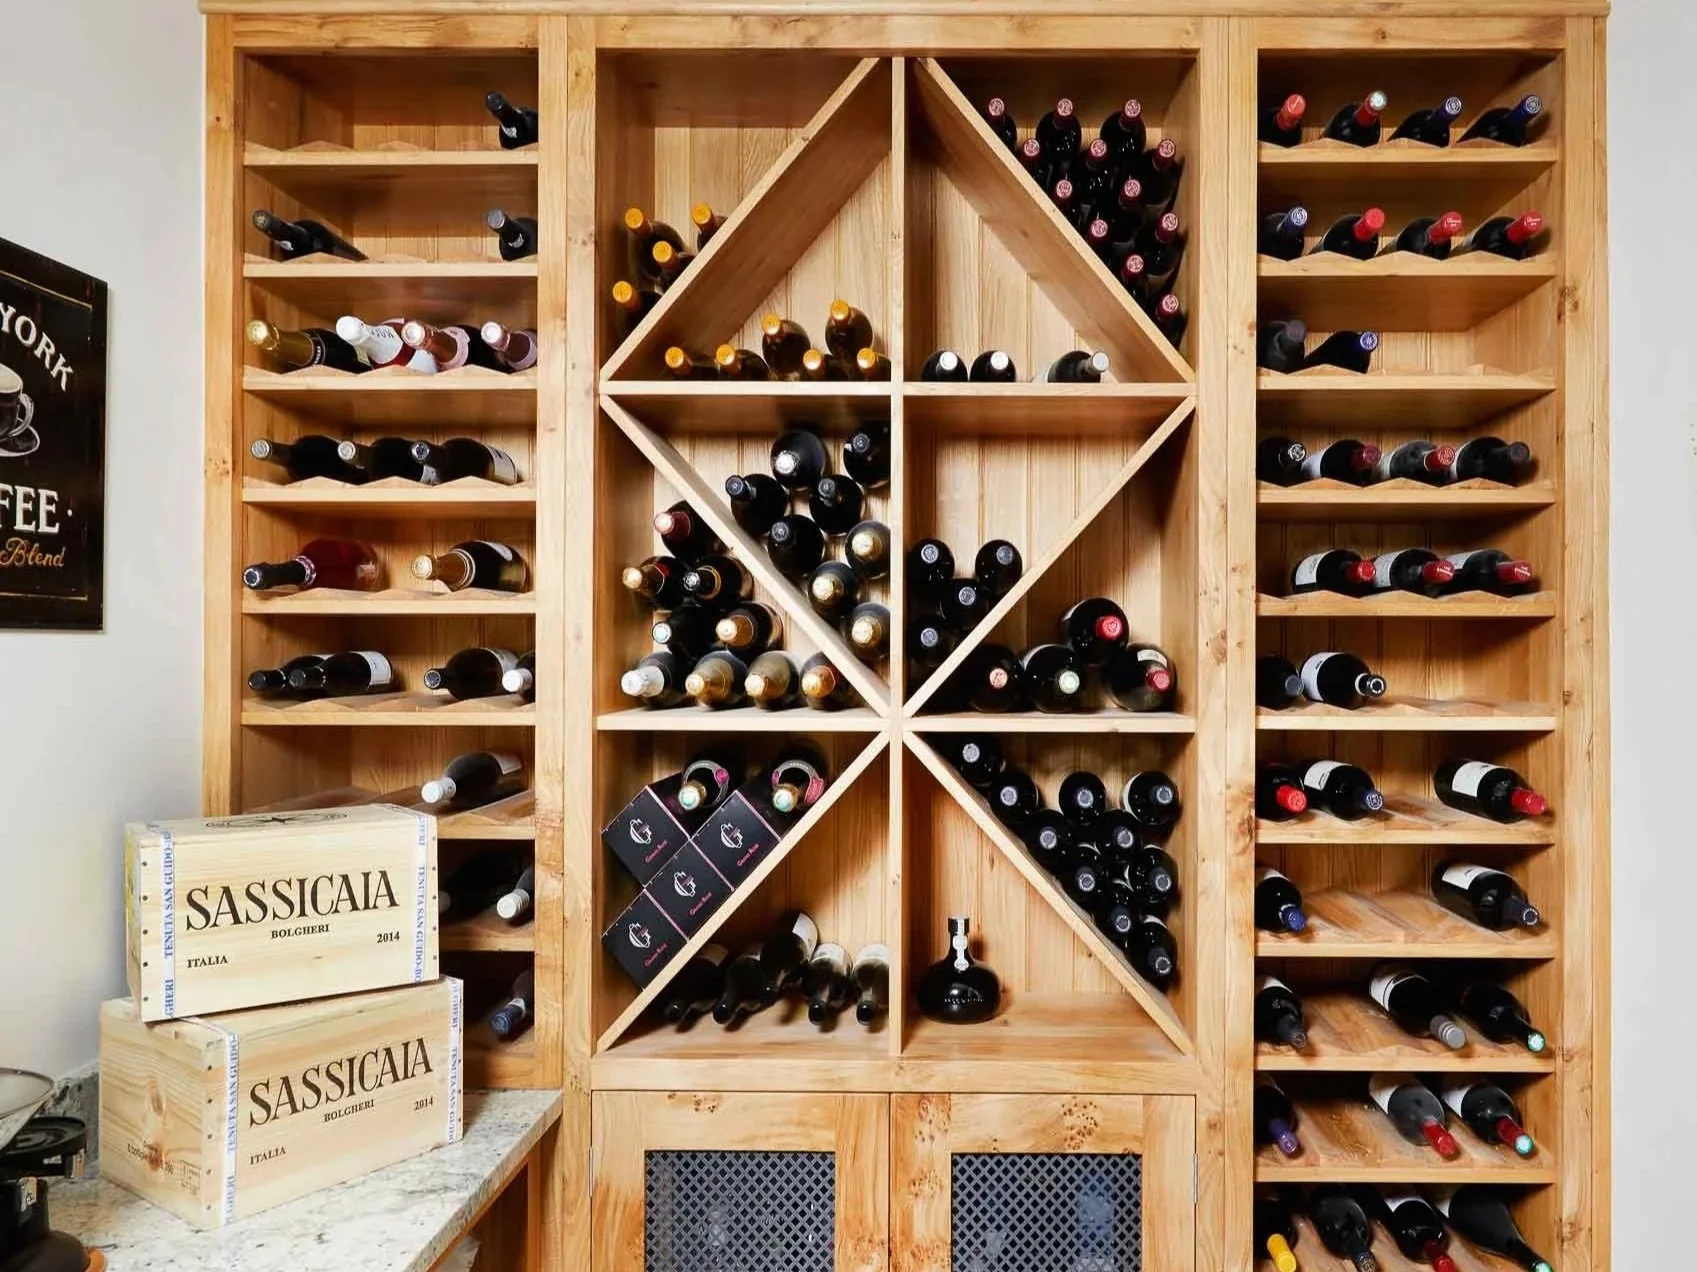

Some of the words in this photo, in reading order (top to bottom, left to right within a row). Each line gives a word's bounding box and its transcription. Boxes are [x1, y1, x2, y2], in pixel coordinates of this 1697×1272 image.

[0, 303, 73, 392] YORK
[0, 537, 66, 567] Blend
[164, 887, 173, 911] SAN
[186, 870, 400, 931] SASSICAIA
[164, 913, 173, 958] TENUTA
[271, 924, 330, 939] BOLGHERI
[376, 931, 400, 943] 2014
[187, 955, 228, 968] ITALIA
[249, 1037, 433, 1128] SASSICAIA
[323, 1099, 375, 1122] BOLGHERI
[414, 1096, 434, 1111] 2014
[250, 1146, 286, 1165] ITALIA
